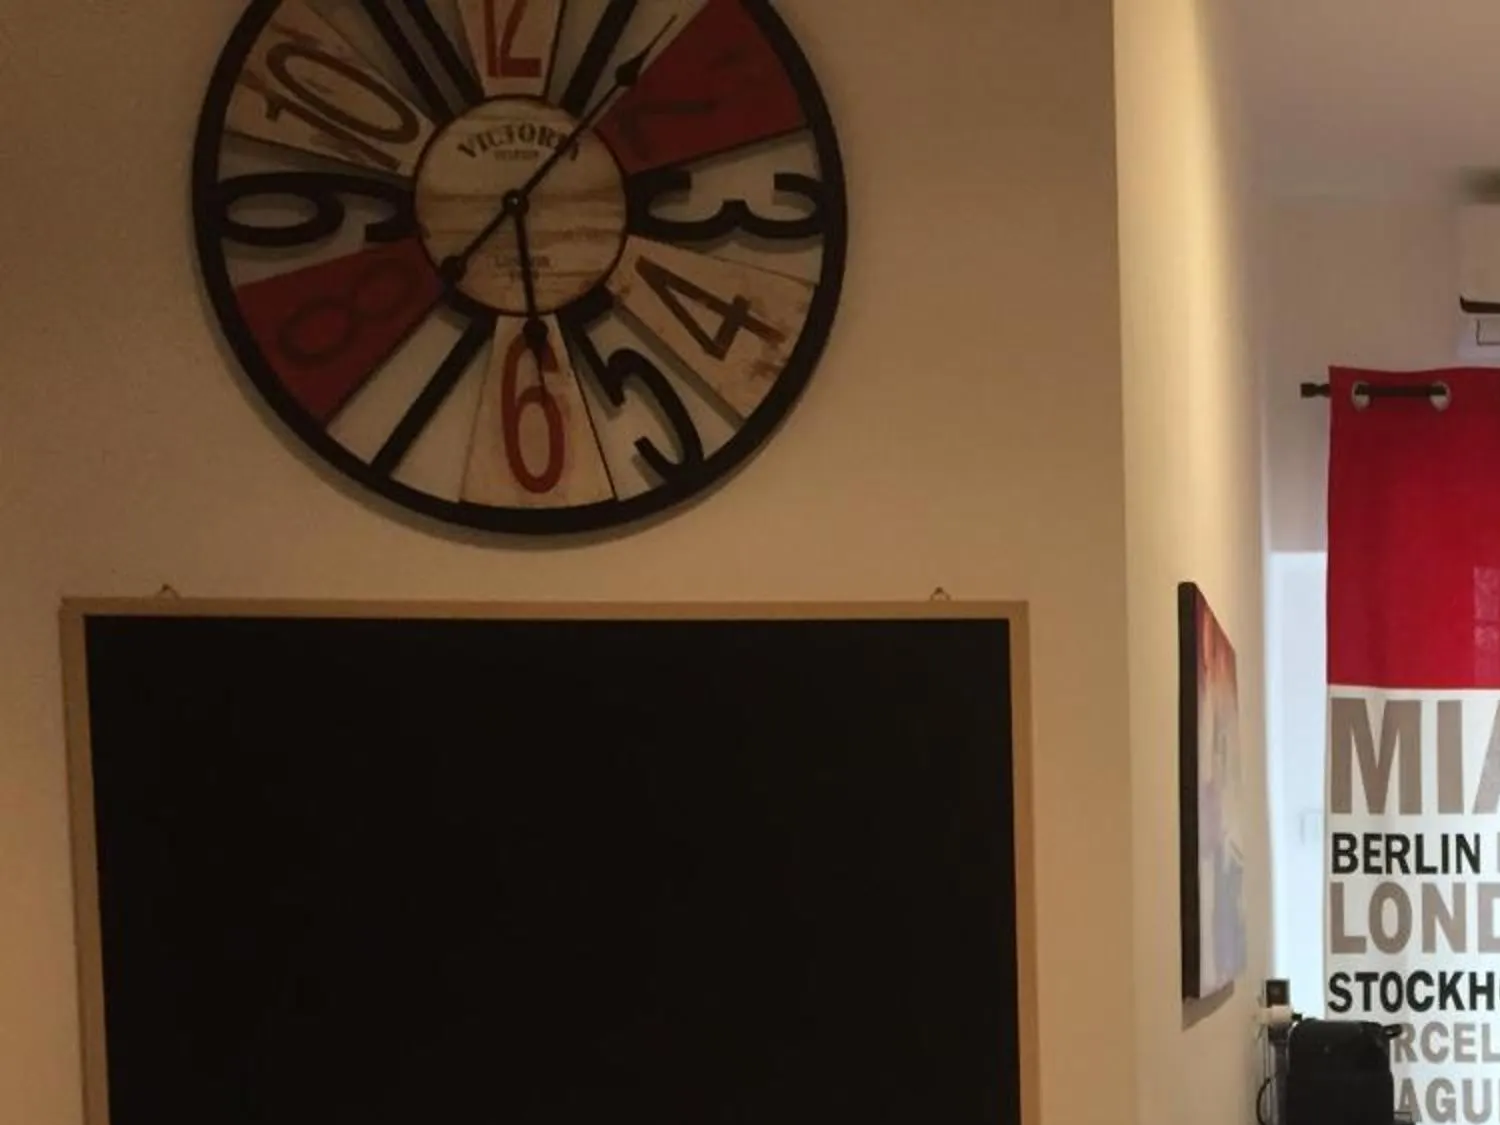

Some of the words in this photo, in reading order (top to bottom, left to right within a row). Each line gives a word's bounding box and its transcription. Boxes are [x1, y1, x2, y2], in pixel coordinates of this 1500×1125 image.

[262, 41, 421, 171] 10
[628, 172, 831, 240] 3
[635, 255, 786, 361] 4
[501, 333, 565, 494] 6
[557, 285, 704, 490] 5
[1332, 832, 1481, 875] BERLIN
